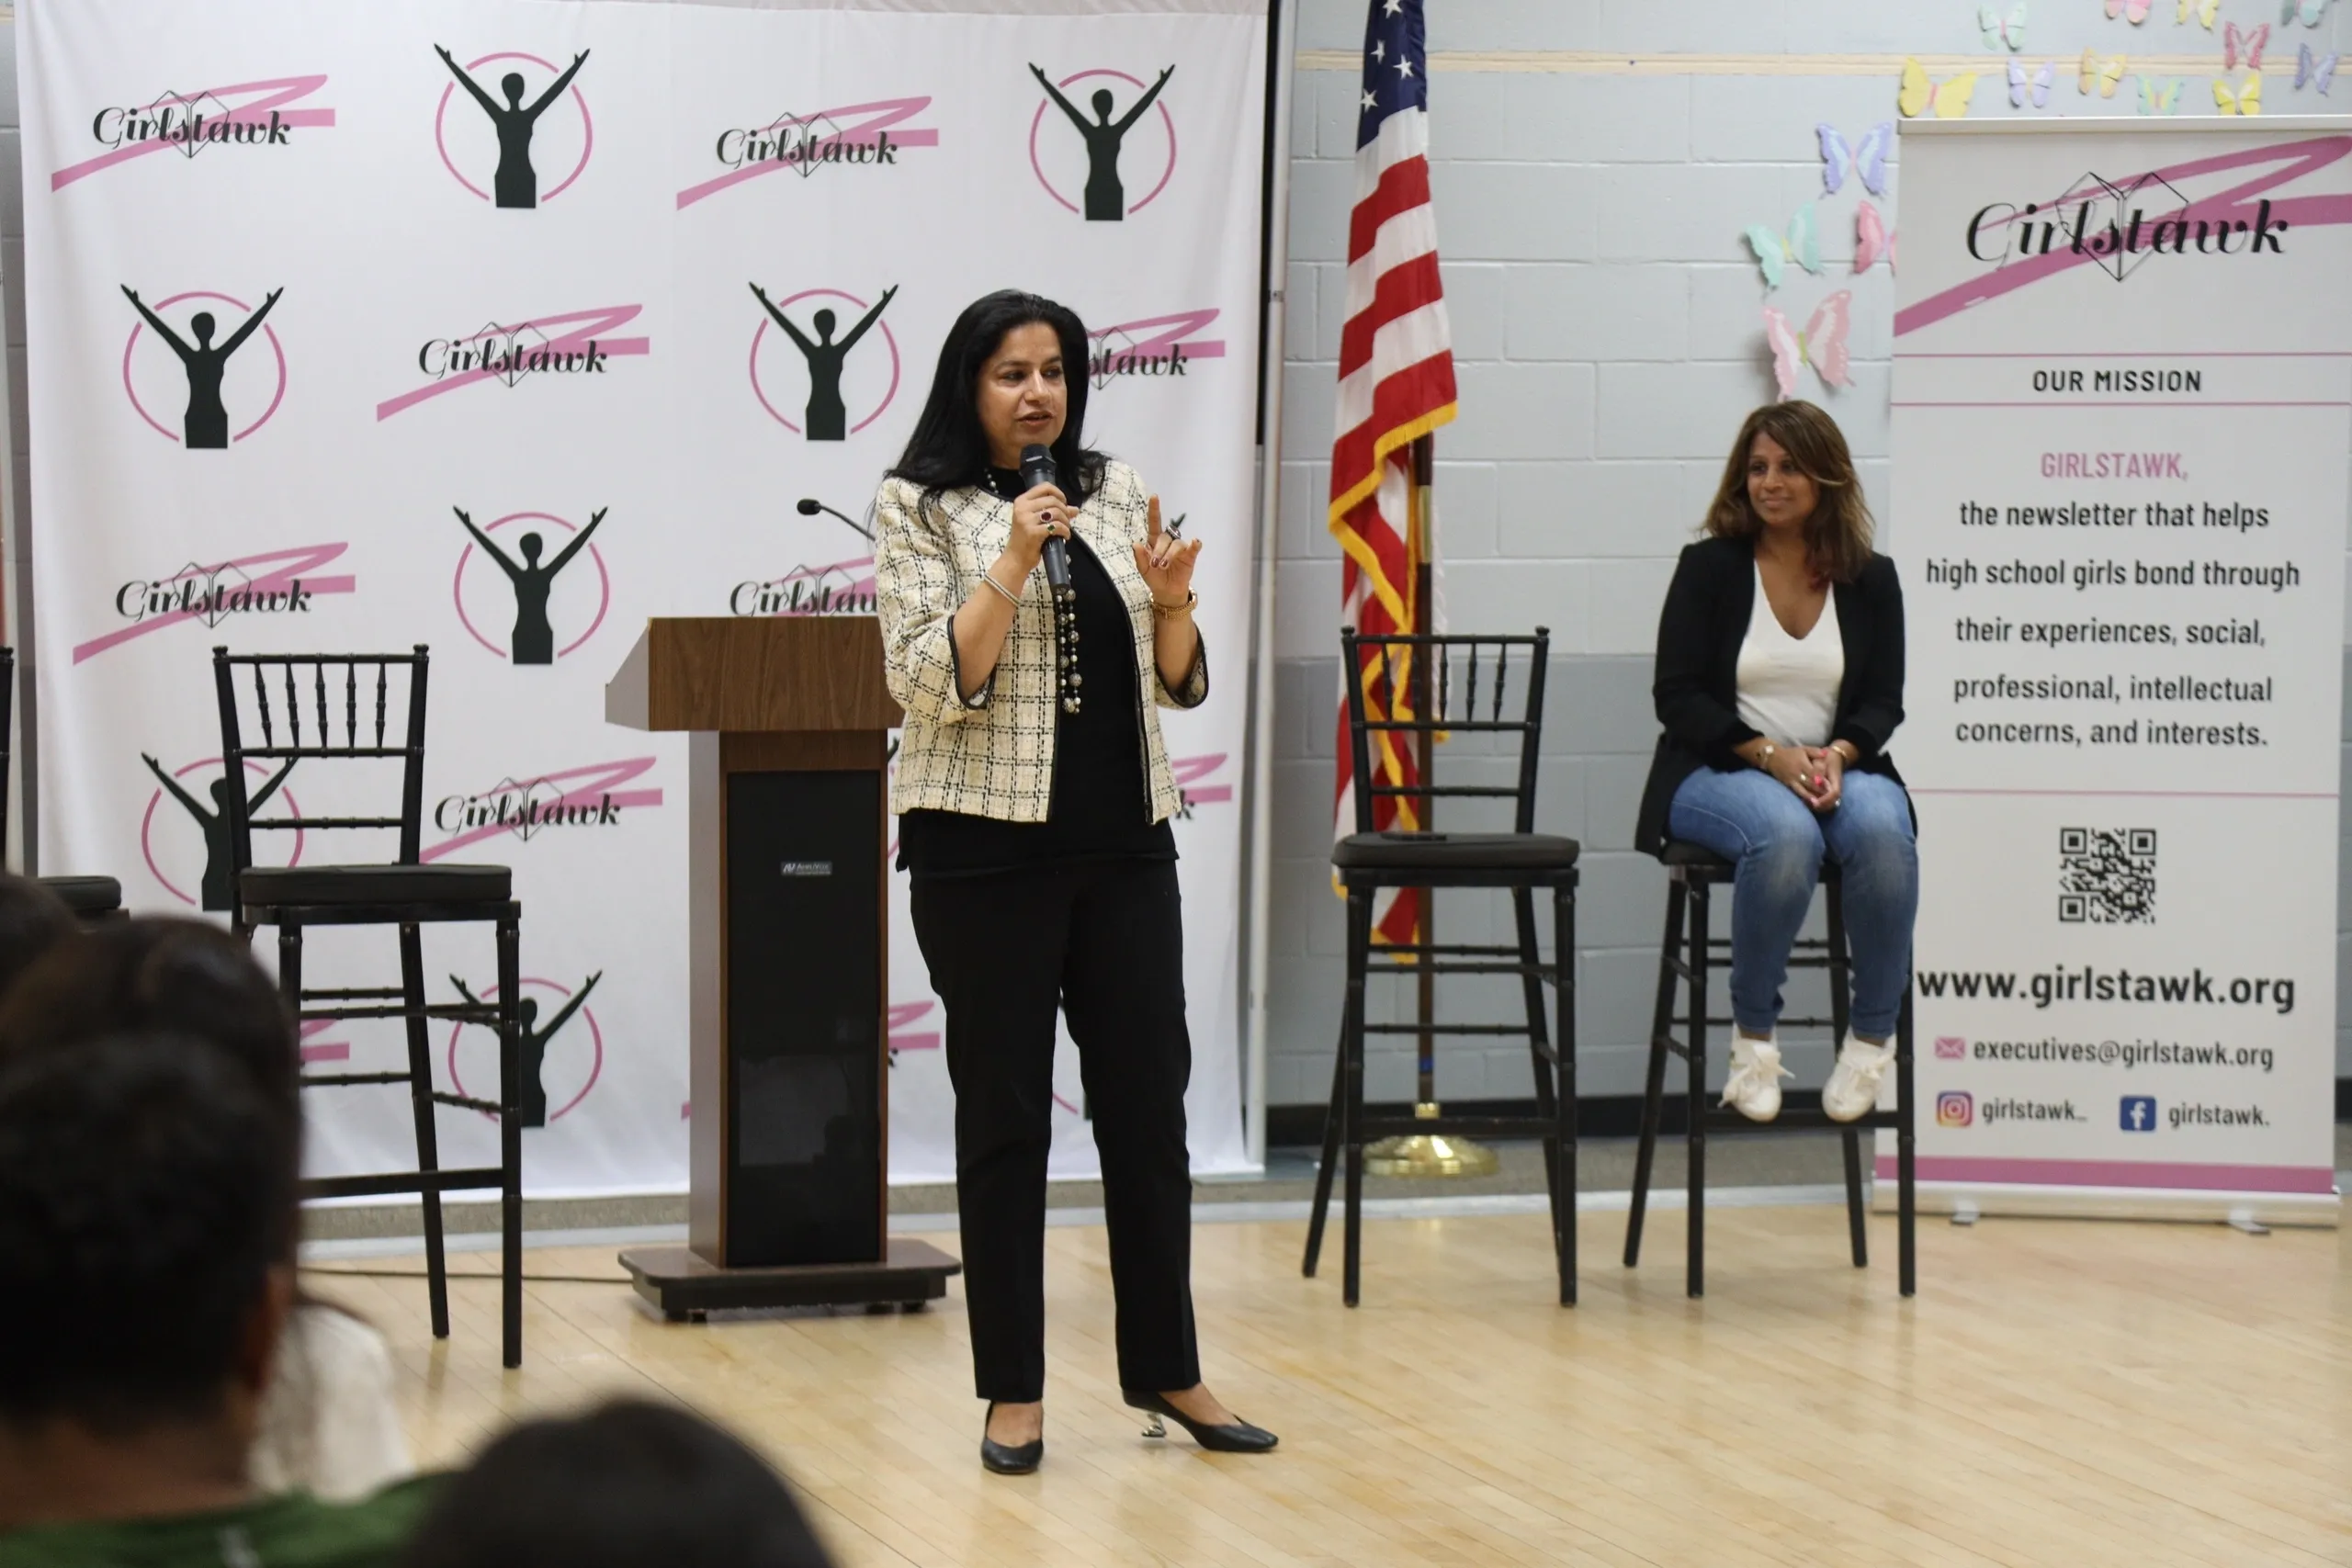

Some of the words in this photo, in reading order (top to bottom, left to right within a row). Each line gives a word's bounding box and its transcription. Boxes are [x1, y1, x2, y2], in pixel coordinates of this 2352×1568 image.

[93, 107, 291, 150] Girlstawk
[717, 128, 899, 170] Girlstawk
[1966, 198, 2289, 272] Girlstawk
[419, 338, 607, 379] Girlstawk
[1089, 343, 1188, 376] stawk
[2033, 370, 2084, 392] OUR
[2093, 369, 2202, 392] MISSION
[2041, 452, 2189, 481] GIRLSTAWK,
[1960, 501, 1998, 526] the
[2007, 501, 2137, 526] newsletter
[2145, 502, 2195, 526] that
[2203, 502, 2269, 533] helps
[1926, 558, 1977, 591] high
[1985, 558, 2064, 584] school
[2073, 558, 2126, 591] girls
[2135, 559, 2194, 585] bond
[2202, 560, 2300, 592] through
[116, 579, 312, 622] Girlstawk
[1955, 616, 2013, 643] their
[2020, 617, 2177, 649] experiences,
[2186, 618, 2266, 647] social,
[1953, 674, 2120, 704] professional,
[2130, 674, 2272, 702] intellectual
[1955, 720, 2082, 748] concerns,
[2089, 718, 2138, 745] and
[2146, 719, 2268, 747] interests.
[435, 794, 621, 837] Girlstawk
[1917, 964, 2295, 1015] www.girlstawk.org
[1973, 1037, 2274, 1073] executives@girlstawk.org
